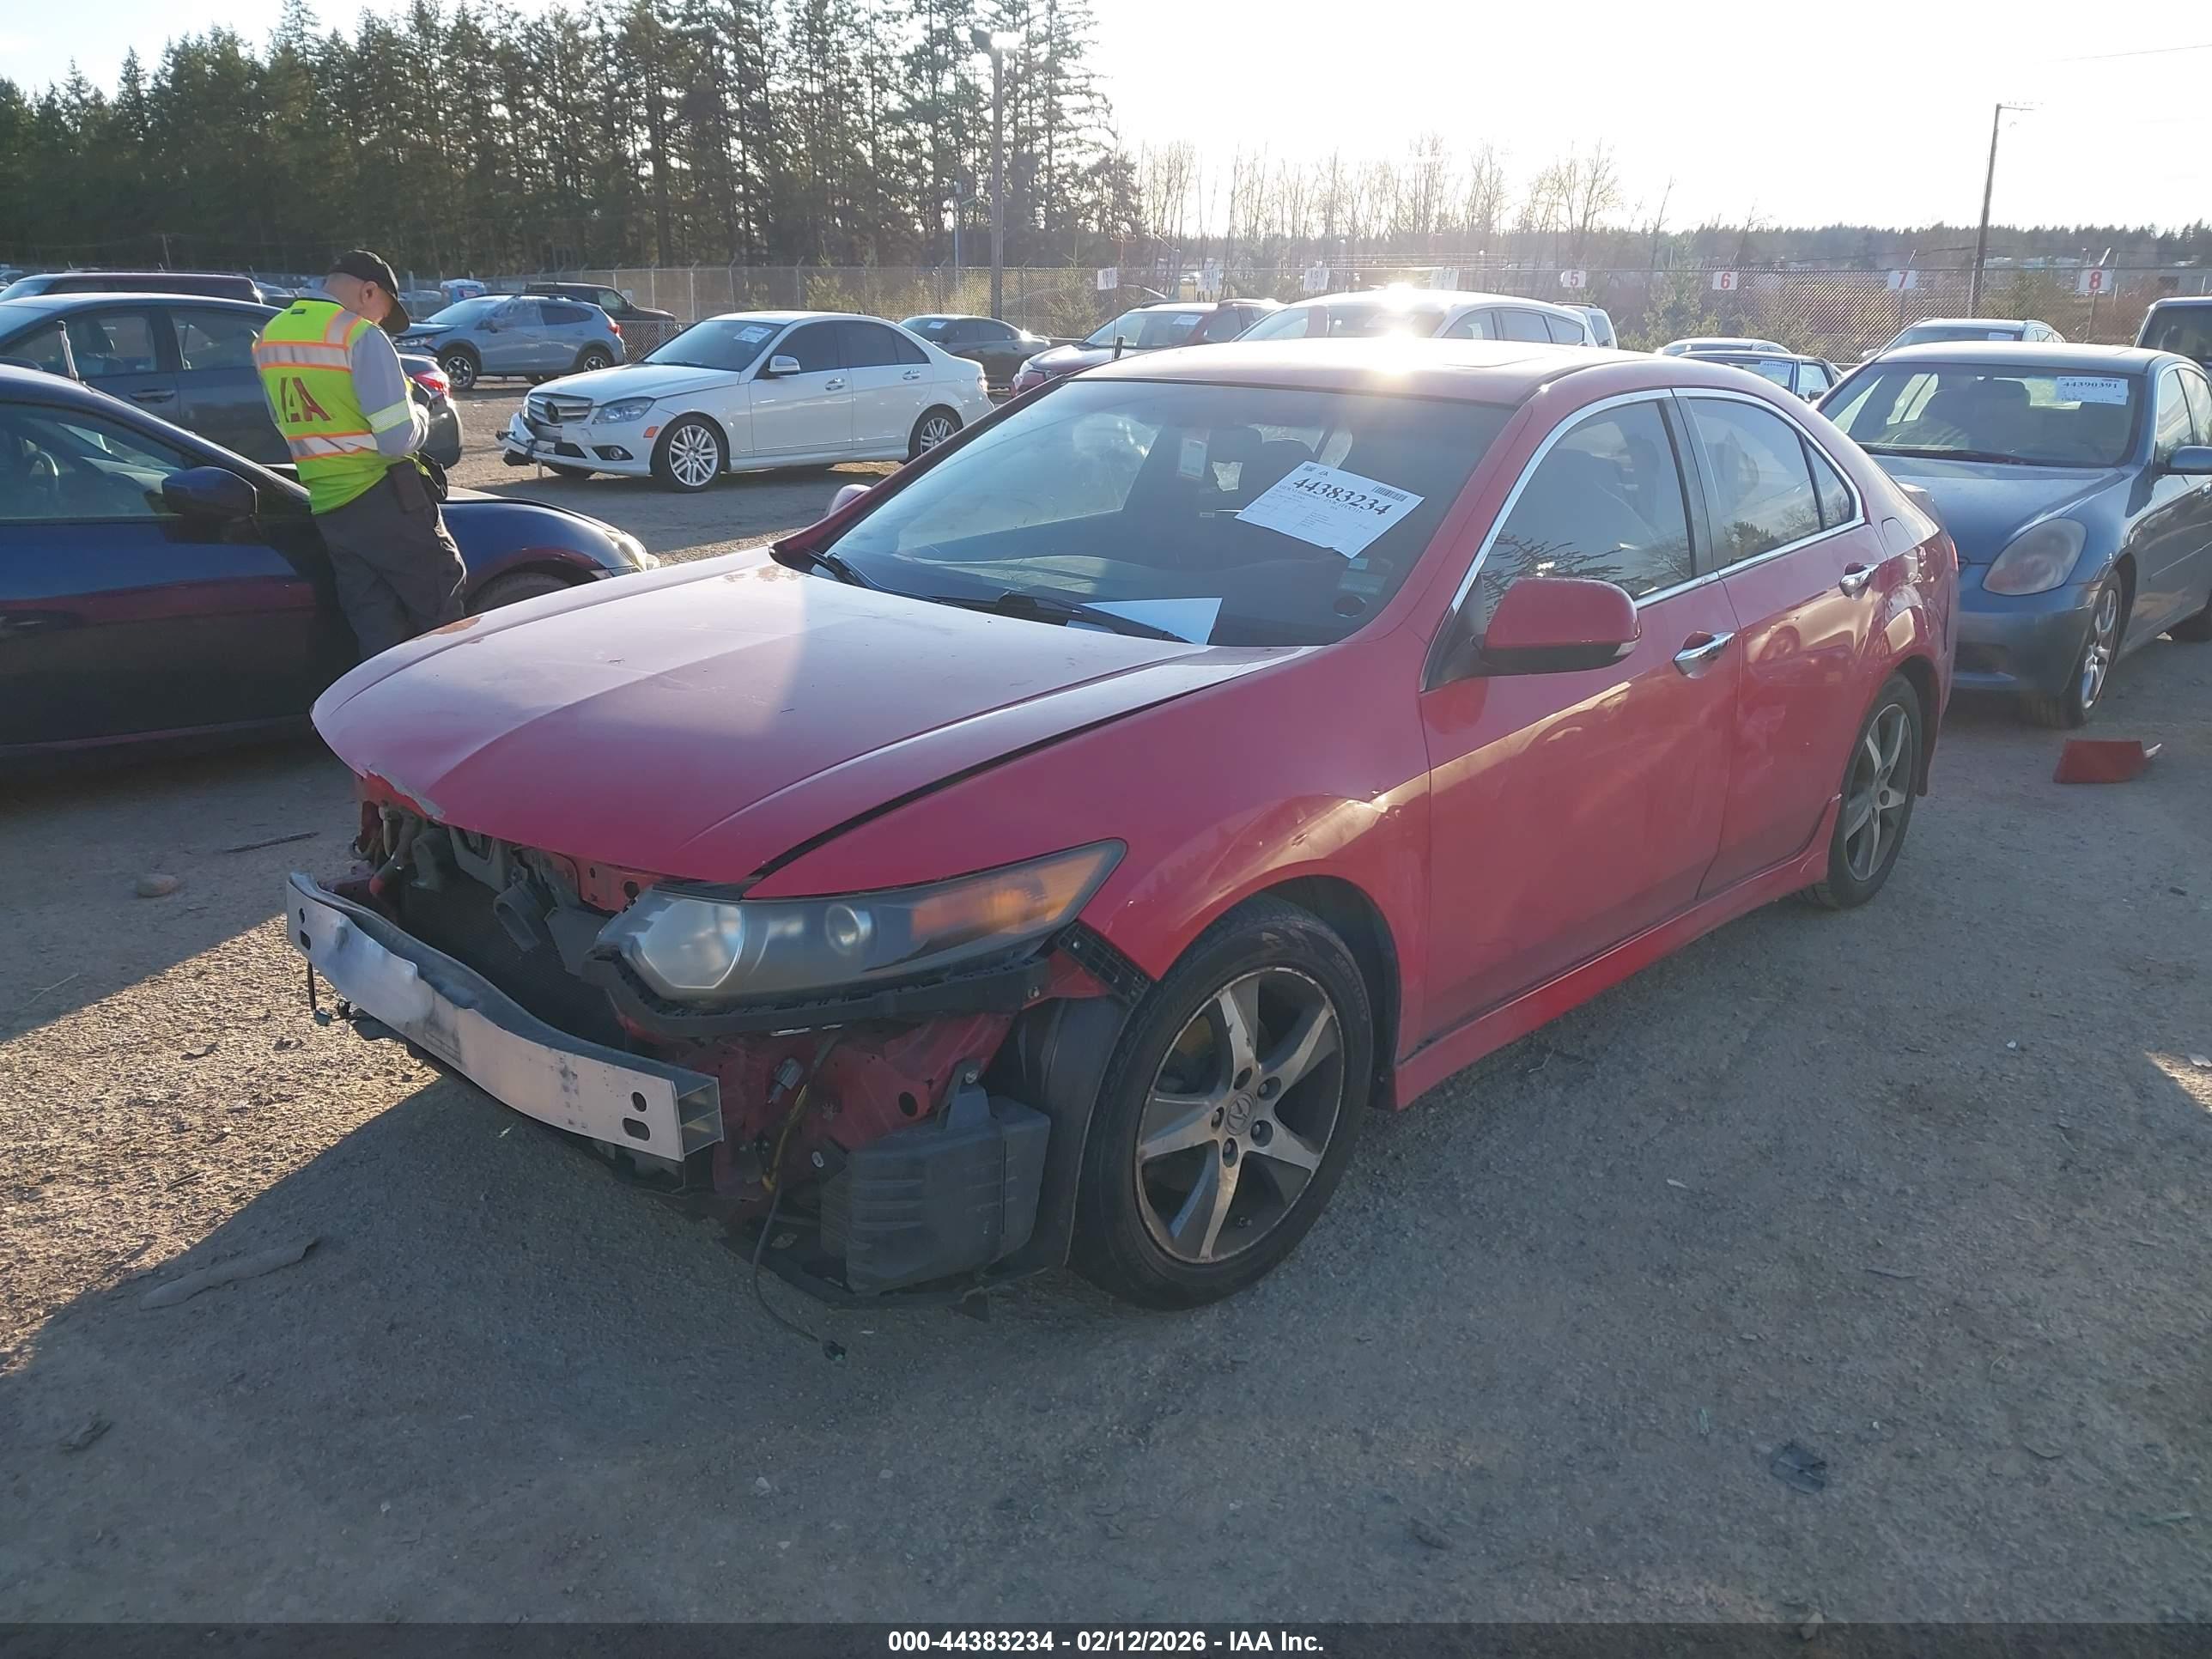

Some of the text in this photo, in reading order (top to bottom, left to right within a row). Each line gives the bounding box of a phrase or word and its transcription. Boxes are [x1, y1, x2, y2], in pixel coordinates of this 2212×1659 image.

[1570, 271, 1579, 287] 5
[1720, 272, 1732, 289] 6
[1898, 270, 1909, 289] 7
[2088, 271, 2103, 290] 8
[1292, 477, 1393, 515] 44383234
